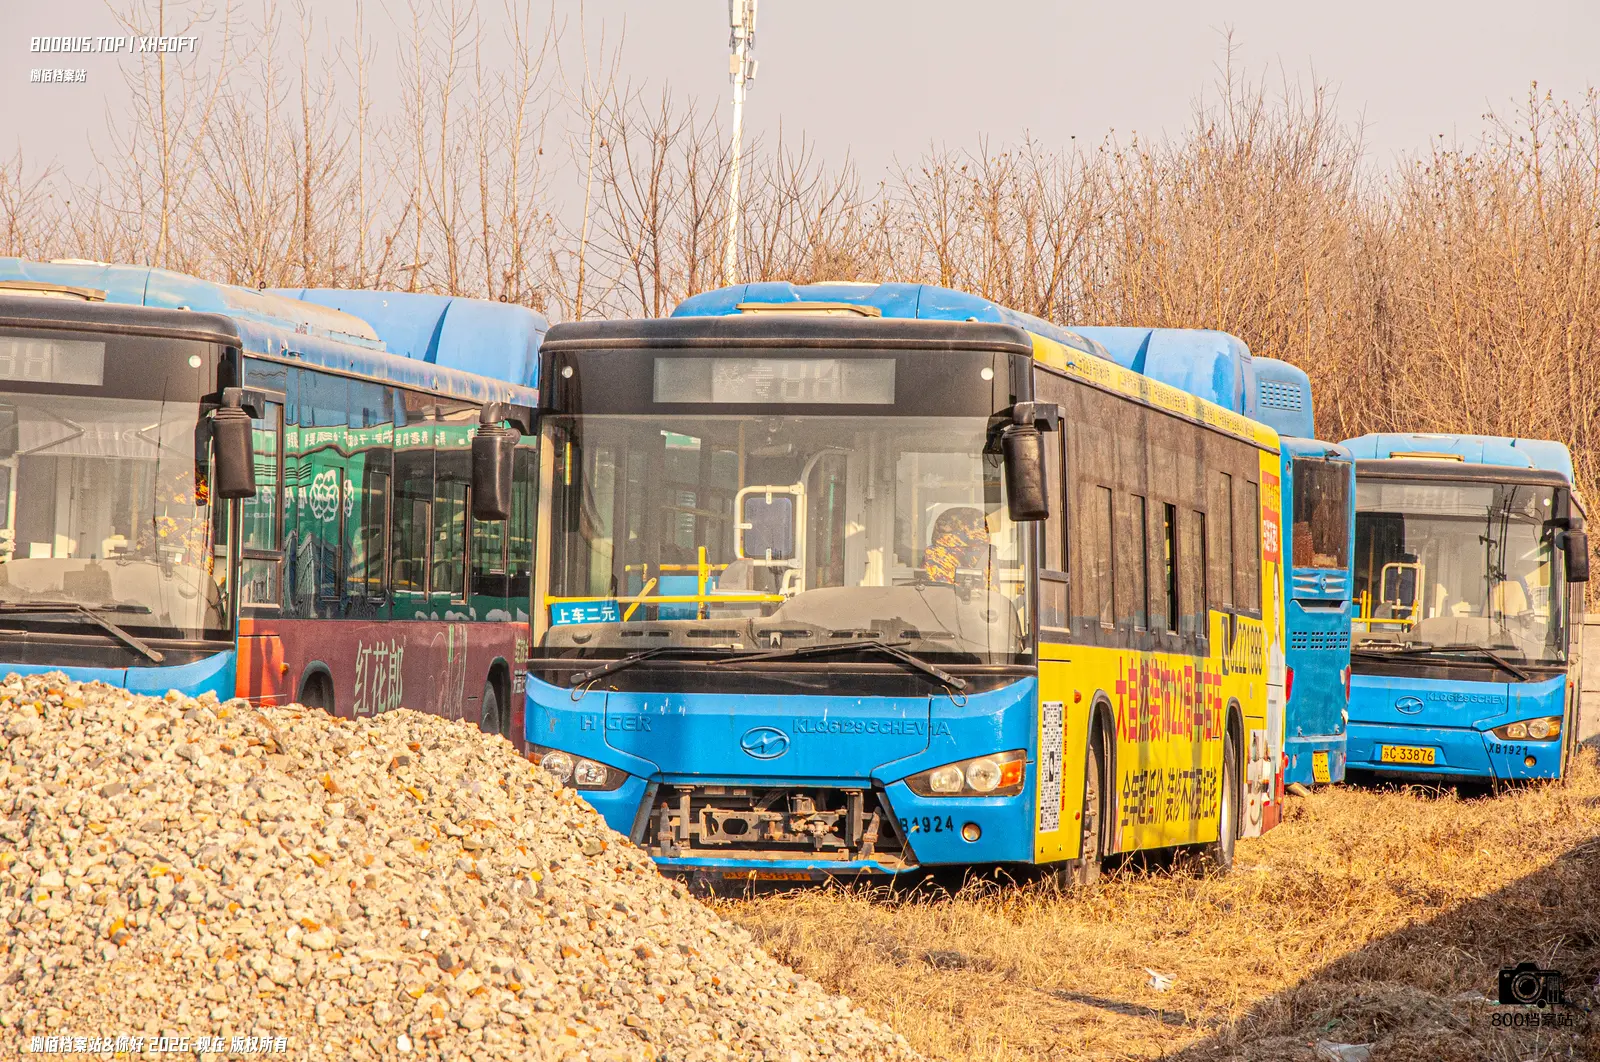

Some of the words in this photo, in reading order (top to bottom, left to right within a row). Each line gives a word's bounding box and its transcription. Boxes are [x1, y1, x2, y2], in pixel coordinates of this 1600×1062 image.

[557, 606, 616, 624] 上车二元
[353, 638, 405, 718] 红花郎
[1115, 656, 1223, 743] 大自然装饰22周年店庆
[1488, 743, 1529, 756] XB1921
